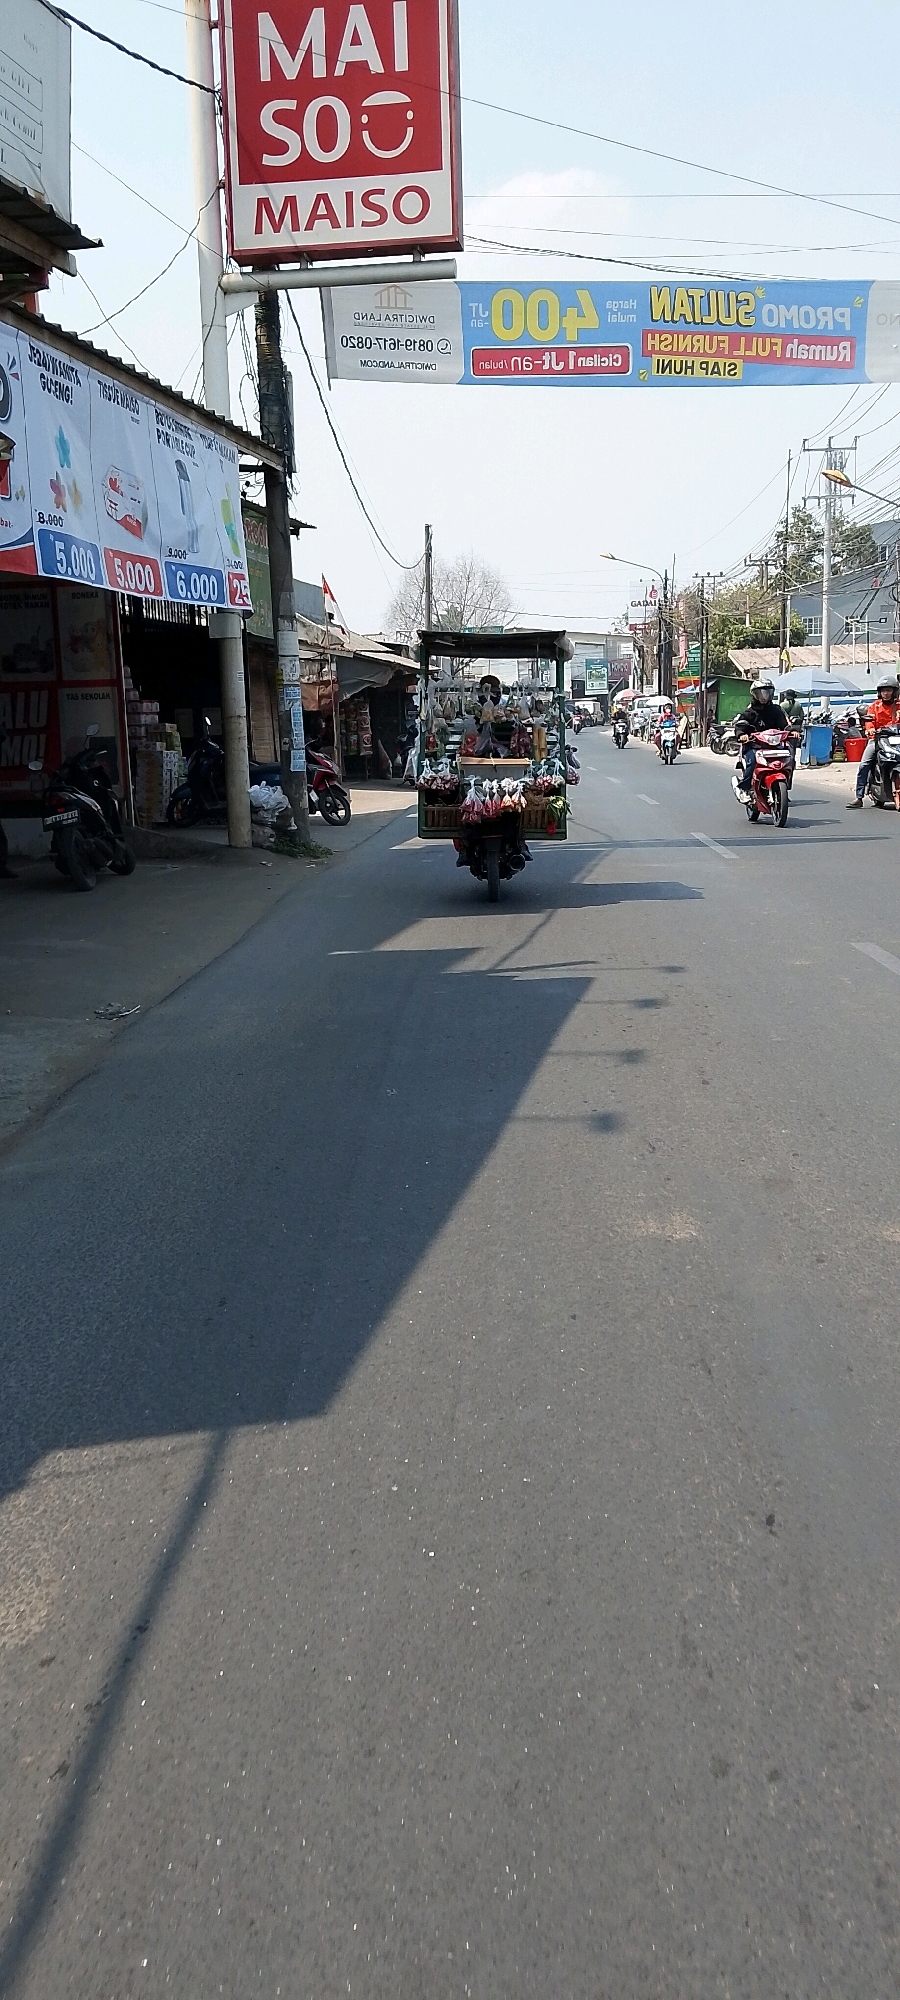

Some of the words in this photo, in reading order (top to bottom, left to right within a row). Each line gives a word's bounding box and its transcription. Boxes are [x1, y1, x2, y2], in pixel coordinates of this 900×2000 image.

[257, 0, 409, 82] MAI
[254, 184, 431, 235] MAISO
[37, 511, 64, 527] 8.000
[55, 540, 96, 581] 5.000
[114, 557, 155, 593] 5.000
[71, 590, 99, 600] BONEKA
[176, 570, 218, 601] 6.000
[66, 693, 79, 701] TAS
[81, 692, 111, 701] SEKOLAH
